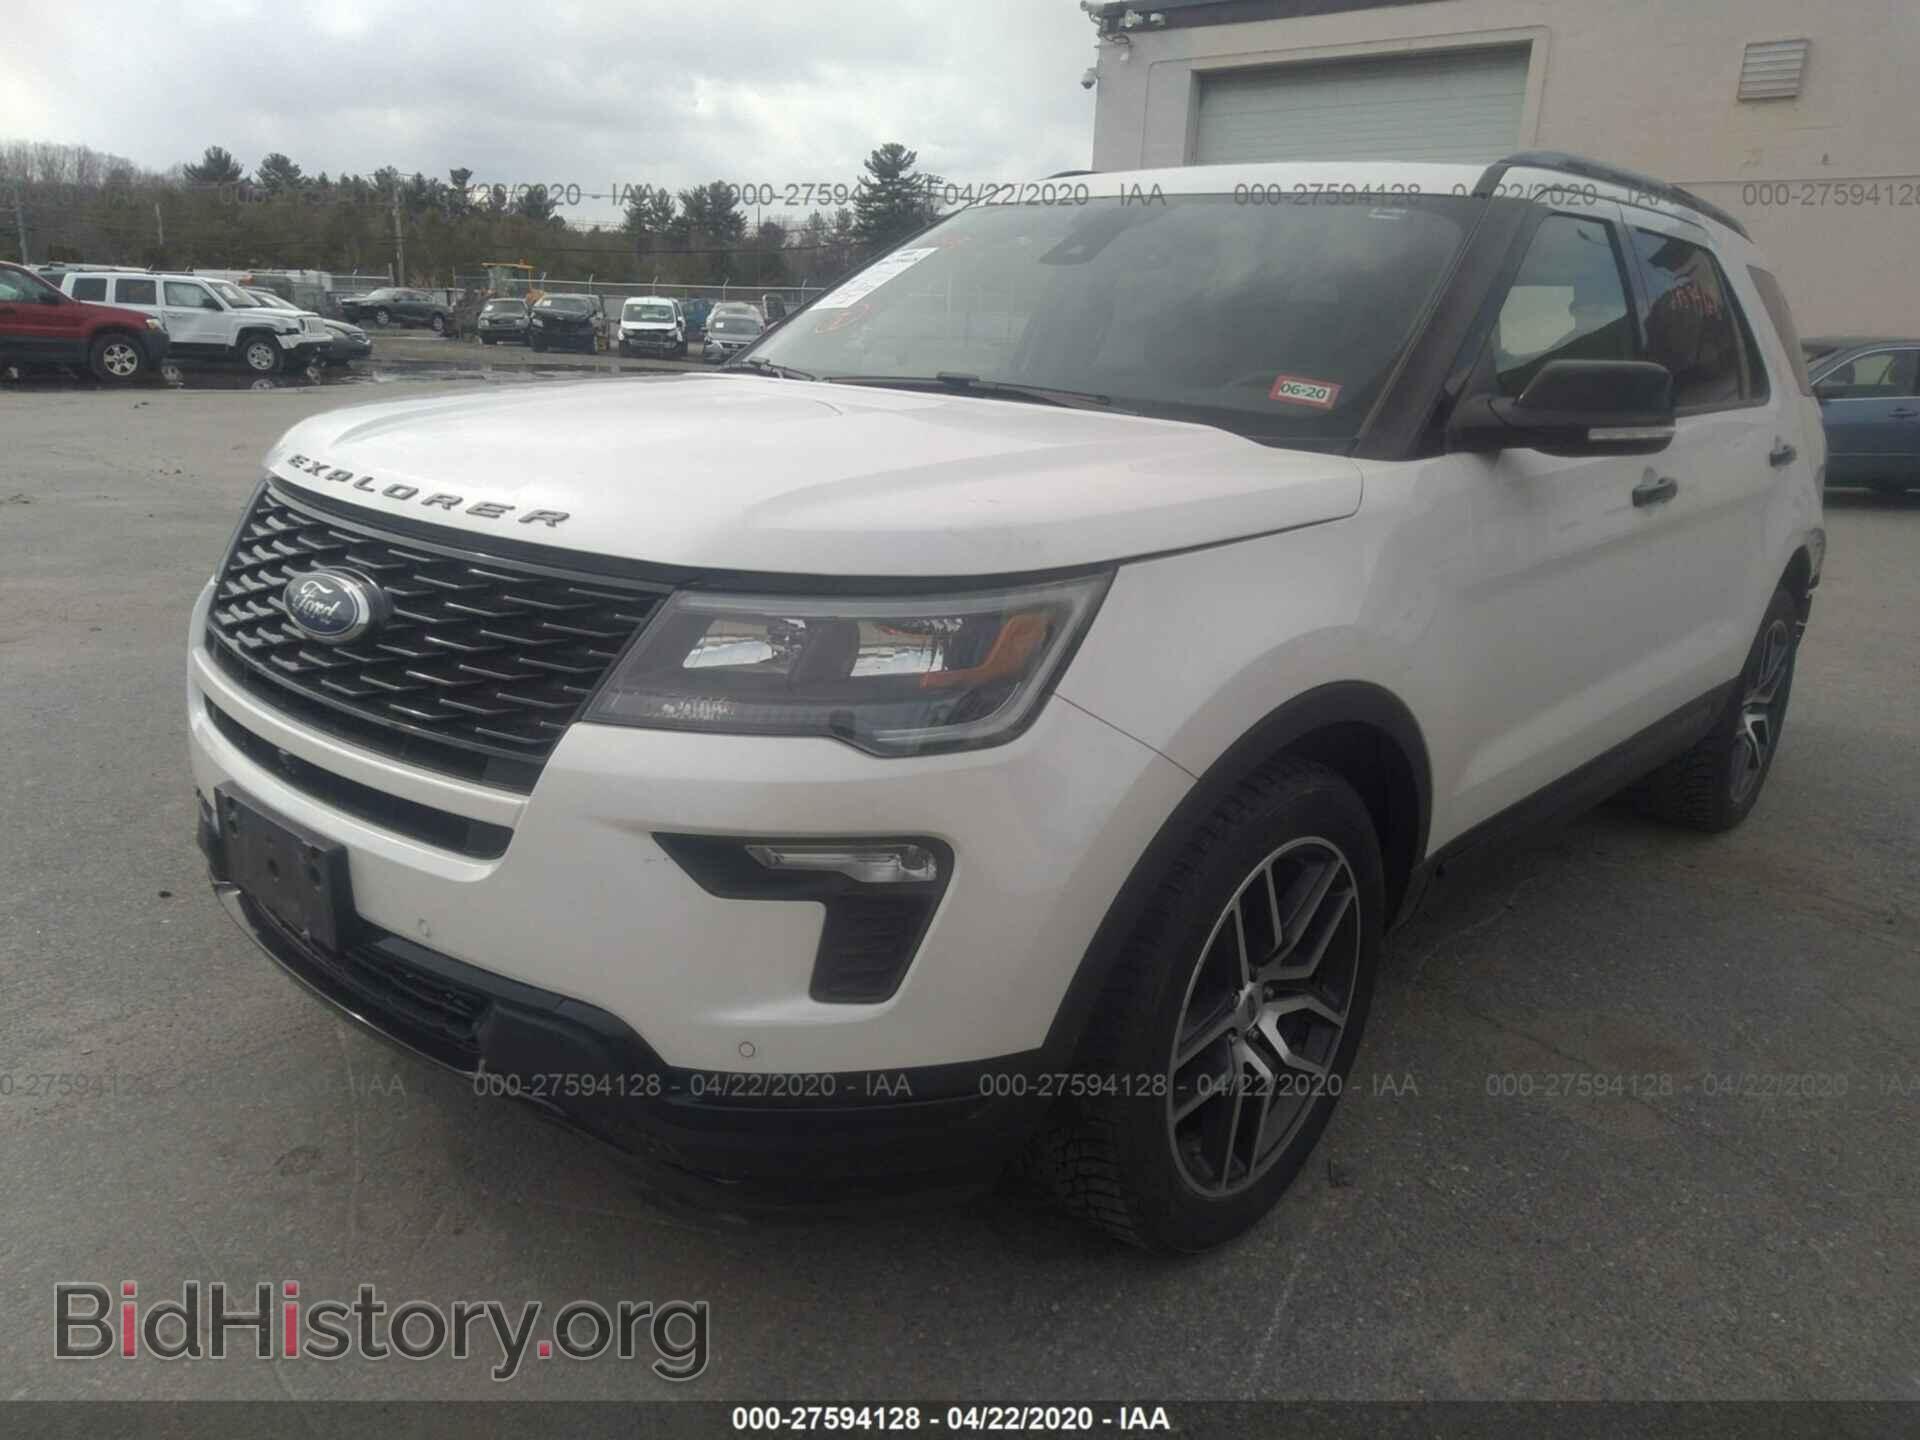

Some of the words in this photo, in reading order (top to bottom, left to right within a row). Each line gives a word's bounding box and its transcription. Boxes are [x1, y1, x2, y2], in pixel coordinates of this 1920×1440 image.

[1280, 383, 1328, 400] 06-20
[288, 454, 571, 528] EXPLORER
[292, 580, 342, 618] Ford
